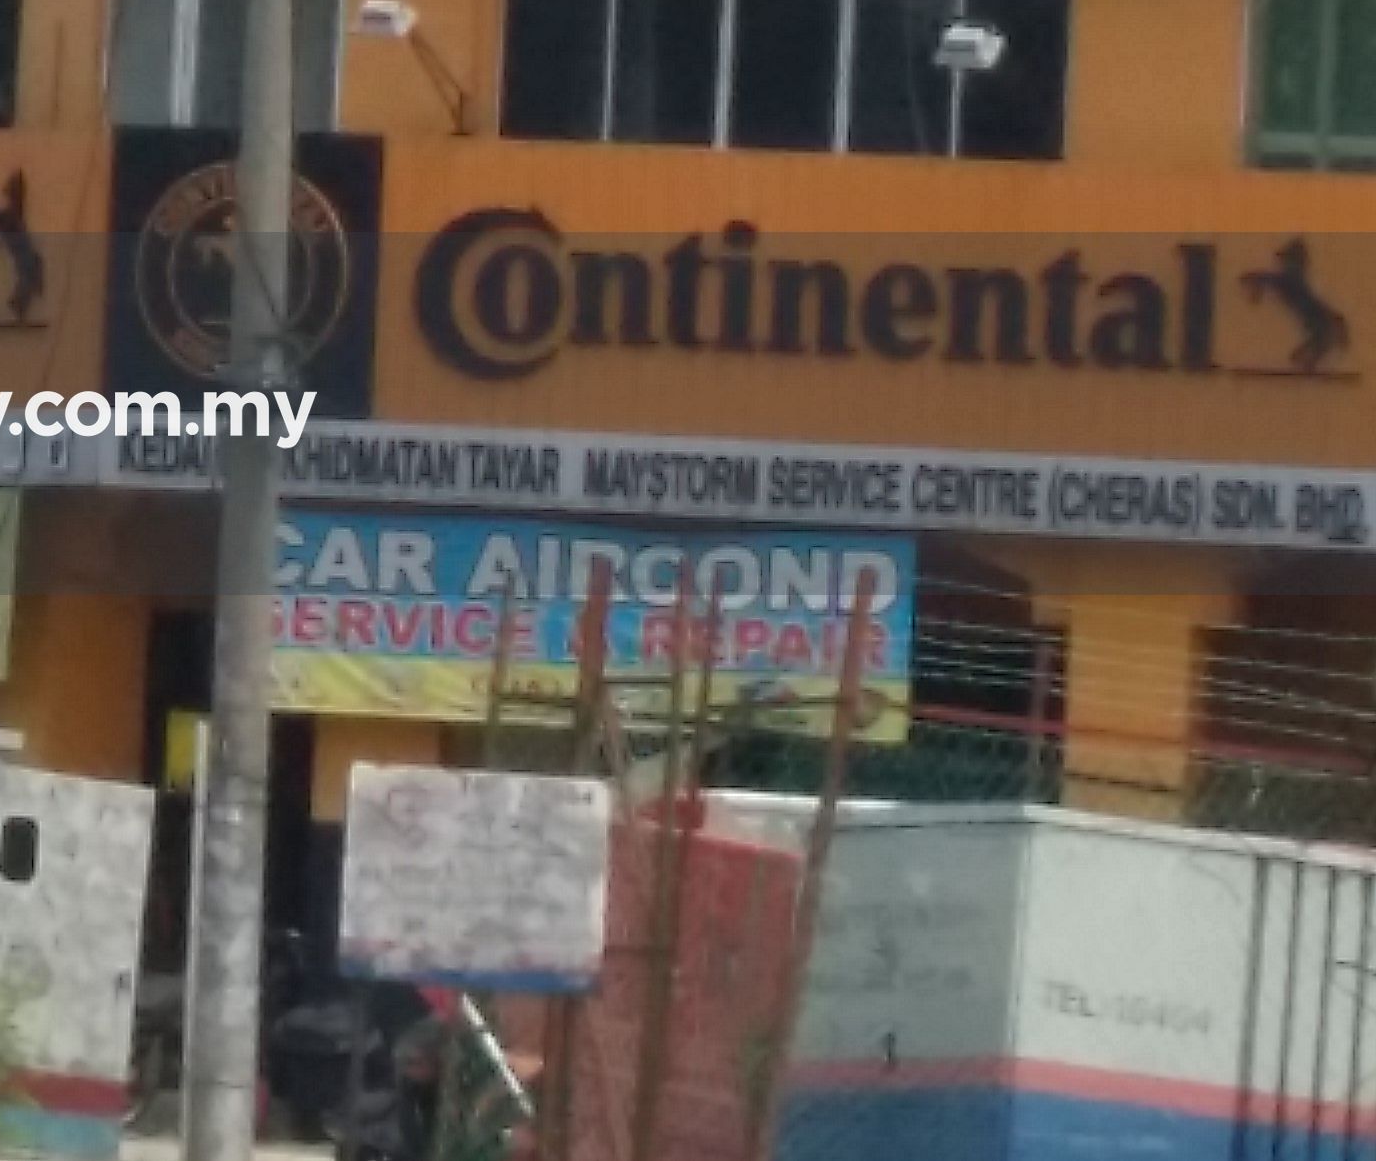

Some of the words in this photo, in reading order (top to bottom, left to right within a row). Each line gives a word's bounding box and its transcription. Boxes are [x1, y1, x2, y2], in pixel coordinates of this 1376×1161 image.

[416, 205, 1219, 380] Continental
[466, 443, 562, 493] TAYAR
[584, 448, 757, 505] MAYSTORM
[768, 456, 904, 511] SERVICE
[912, 463, 1040, 520] CENTRE
[1052, 465, 1201, 534] (CHERAS)
[466, 531, 898, 613] AIRCOND
